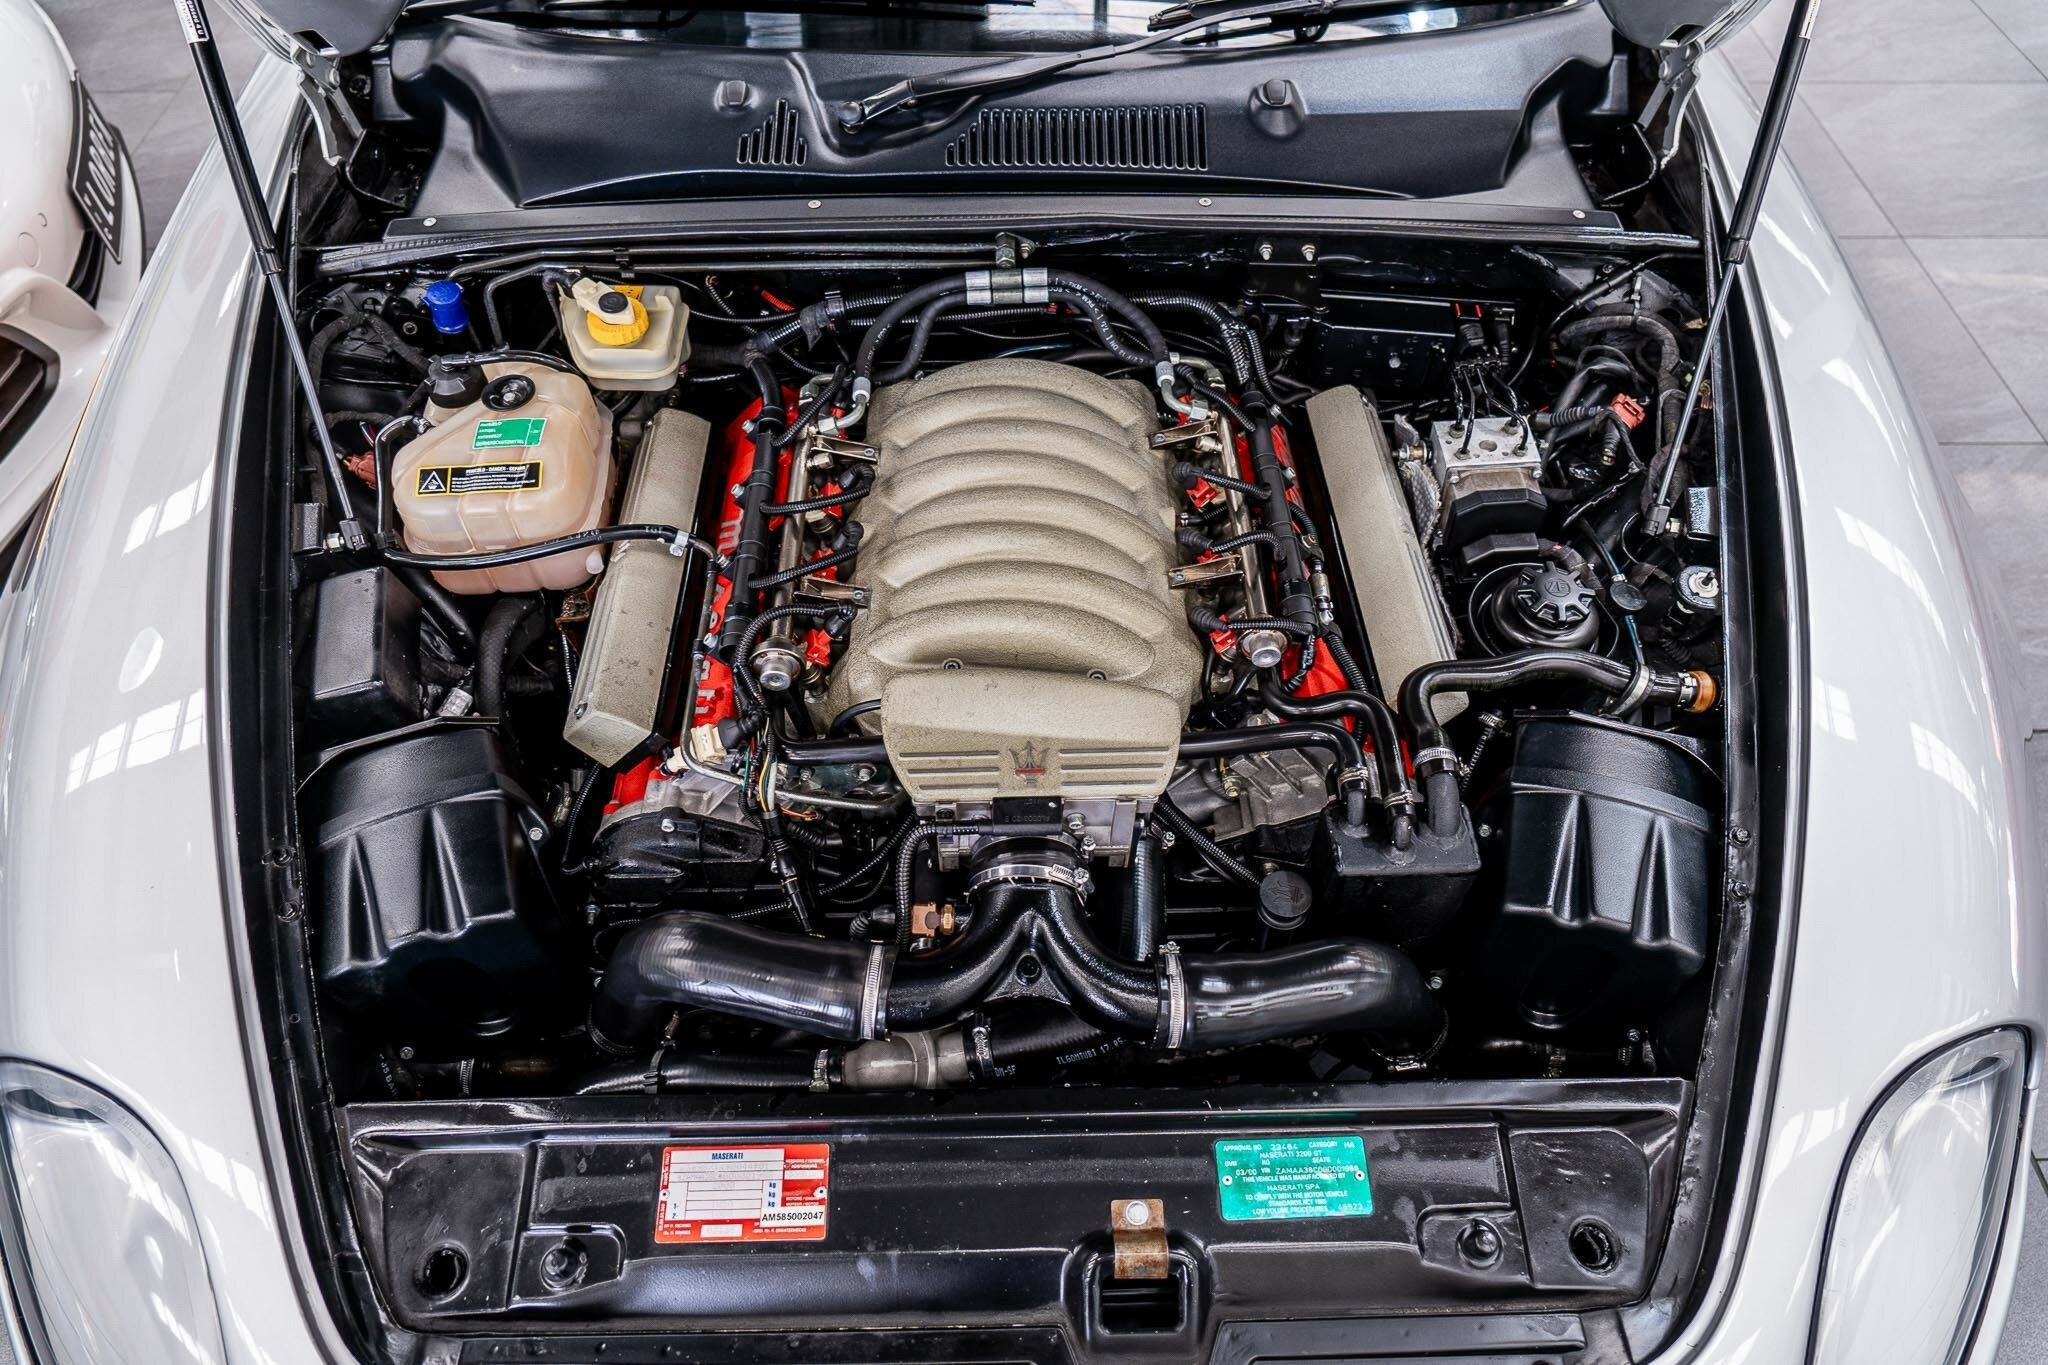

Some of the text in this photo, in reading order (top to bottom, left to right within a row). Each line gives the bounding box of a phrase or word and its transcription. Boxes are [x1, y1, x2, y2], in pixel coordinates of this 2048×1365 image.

[711, 1152, 744, 1161] MASERATI
[1260, 1151, 1294, 1159] MASERATI
[1266, 1183, 1304, 1191] MASERATI
[761, 1210, 824, 1223] AM585002047
